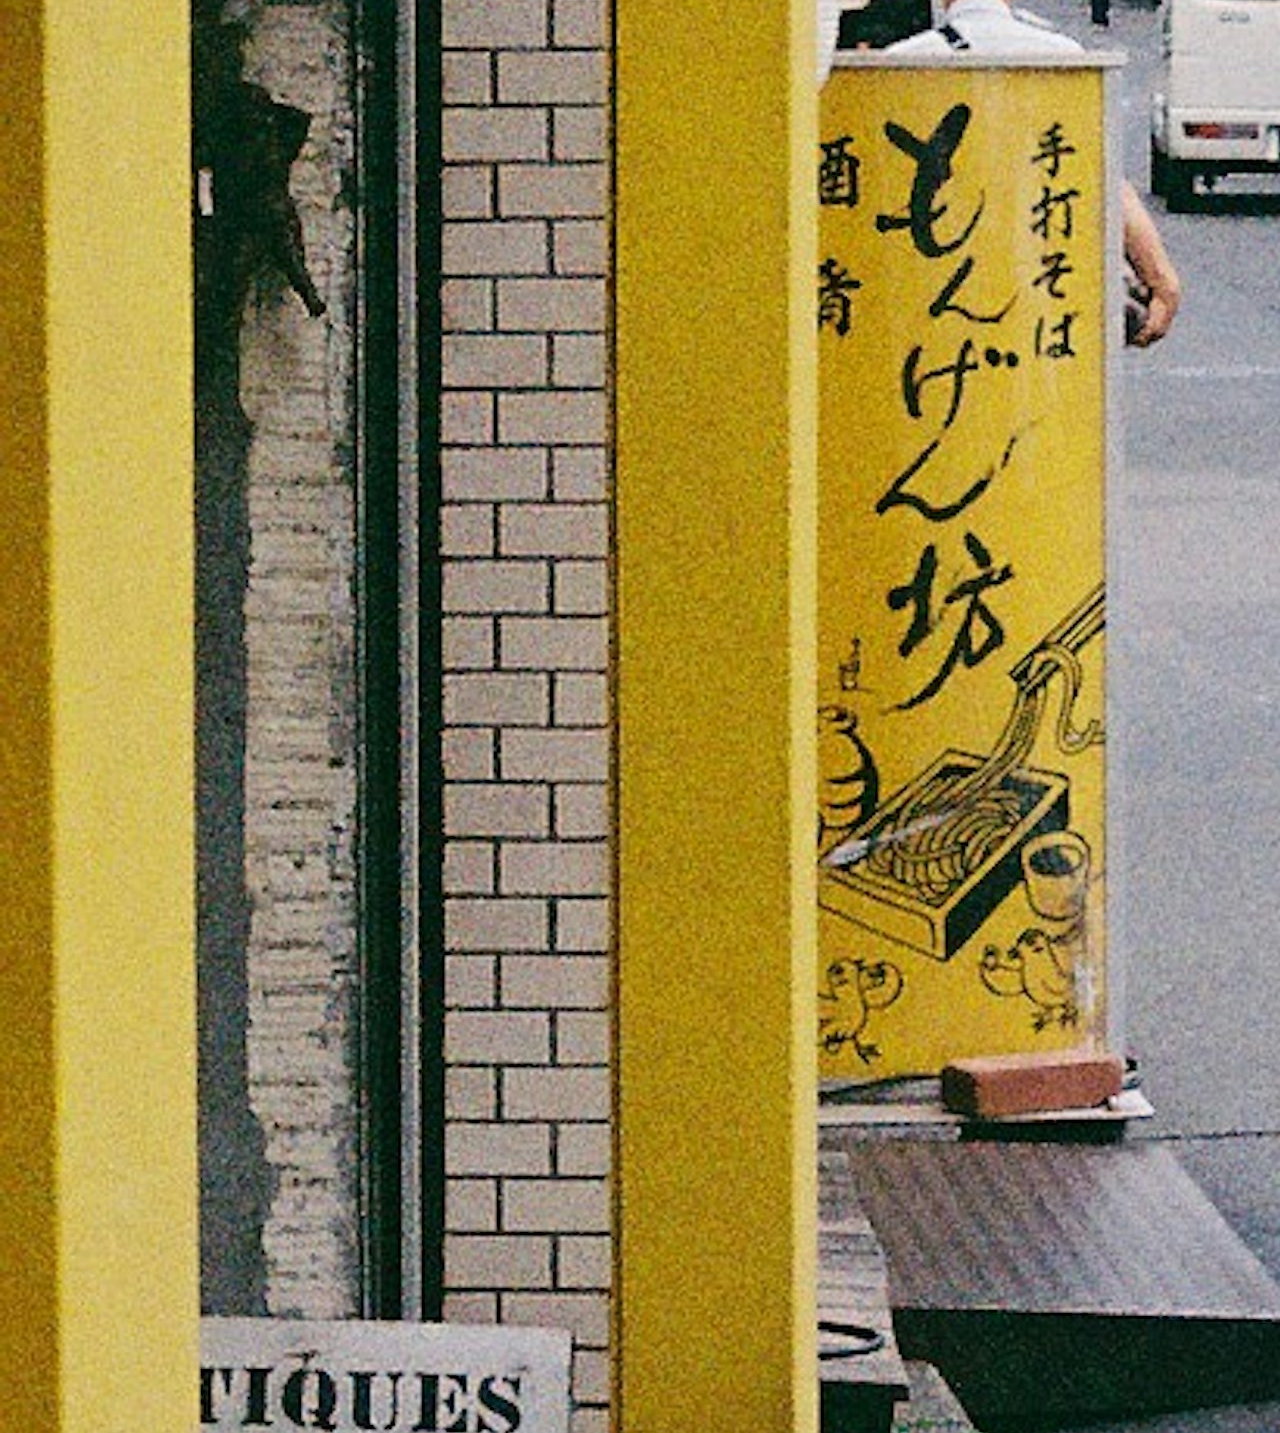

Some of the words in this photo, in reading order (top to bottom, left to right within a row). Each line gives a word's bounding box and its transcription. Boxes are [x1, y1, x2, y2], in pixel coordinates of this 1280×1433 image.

[875, 103, 1022, 714] もんげん坊
[1030, 122, 1083, 360] 手打そば
